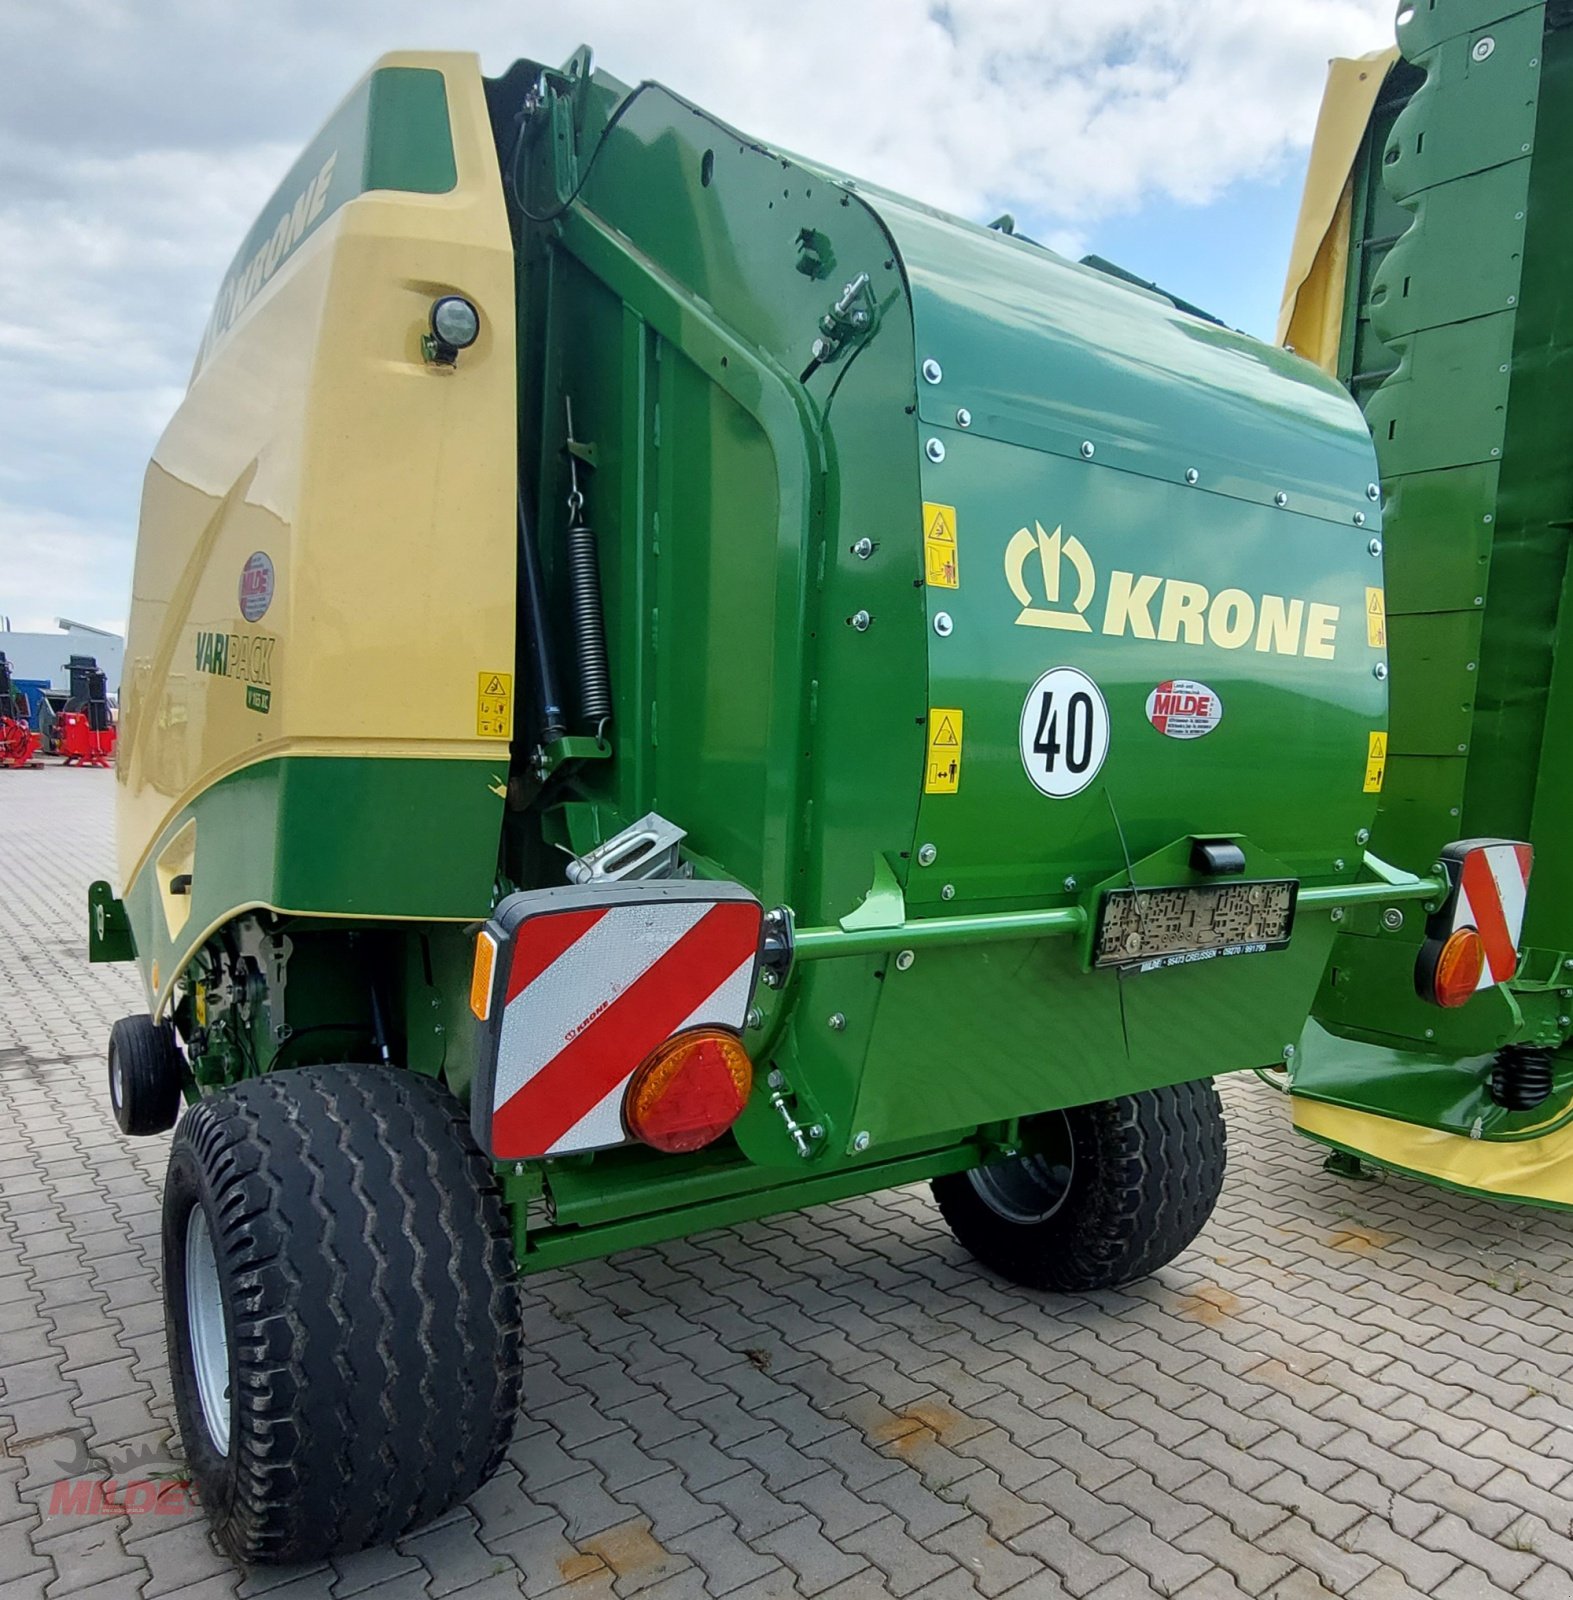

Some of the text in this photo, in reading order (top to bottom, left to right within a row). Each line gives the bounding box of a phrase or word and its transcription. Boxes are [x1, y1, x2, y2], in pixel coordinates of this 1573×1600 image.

[1102, 570, 1341, 660] KRONE
[196, 632, 275, 686] VARIPACK
[1033, 691, 1094, 774] 40
[1153, 694, 1209, 717] MILDE
[577, 1000, 609, 1032] KRONE
